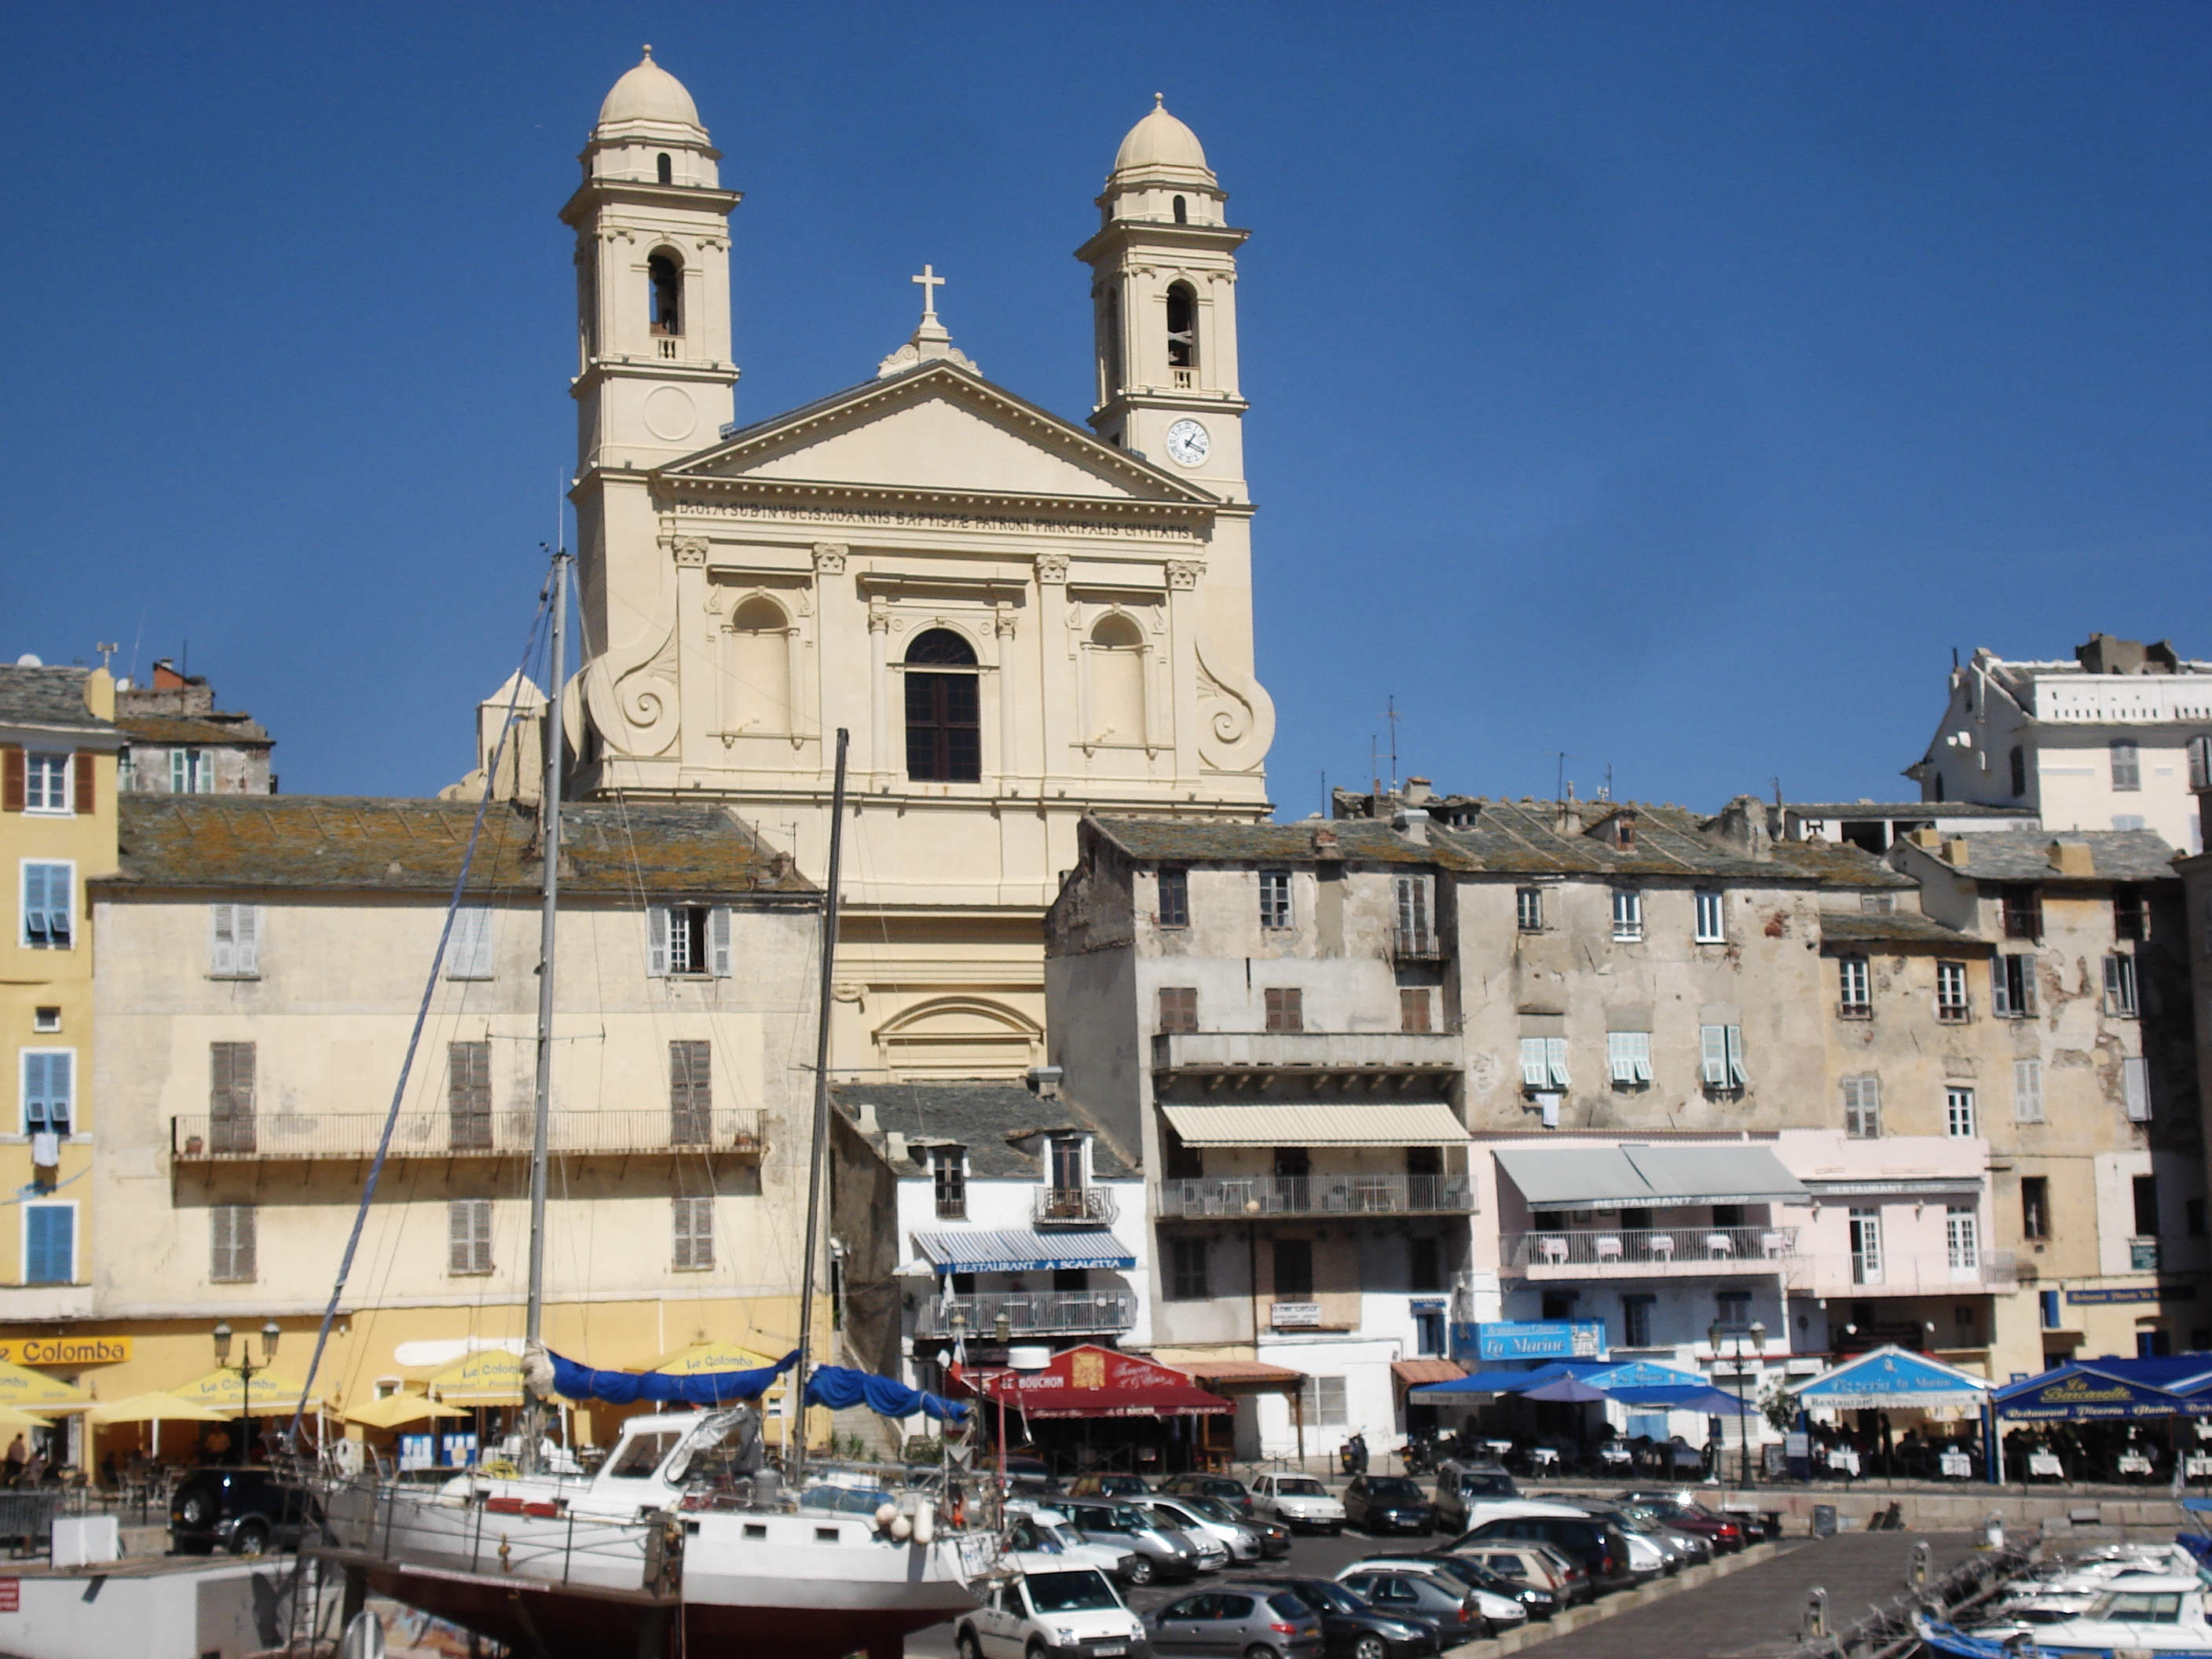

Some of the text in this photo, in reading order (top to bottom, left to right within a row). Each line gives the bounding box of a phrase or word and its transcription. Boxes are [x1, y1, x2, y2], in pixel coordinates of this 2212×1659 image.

[731, 503, 759, 518] SUB
[829, 508, 890, 524] JOANNIS
[976, 515, 1030, 532] PATRONI
[1035, 518, 1119, 536] PRINCIPALIS
[1124, 523, 1189, 539] CIVITATIS
[1827, 1185, 1904, 1193] RESTAURANT
[1594, 1196, 1693, 1209] RESTAURANT
[955, 1259, 1121, 1273] RESTAURANT A SCALETTA
[23, 1341, 124, 1361] Colomba
[1485, 1338, 1565, 1357] La Marine
[687, 1356, 753, 1369] Le Colomba
[462, 1368, 477, 1379] Le
[201, 1382, 217, 1393] Le
[1001, 1376, 1064, 1390] LE BOUCHON
[1811, 1397, 1873, 1407] Restaurant
[2006, 1408, 2069, 1418] Restaurant
[2076, 1405, 2125, 1417] Pizzeria
